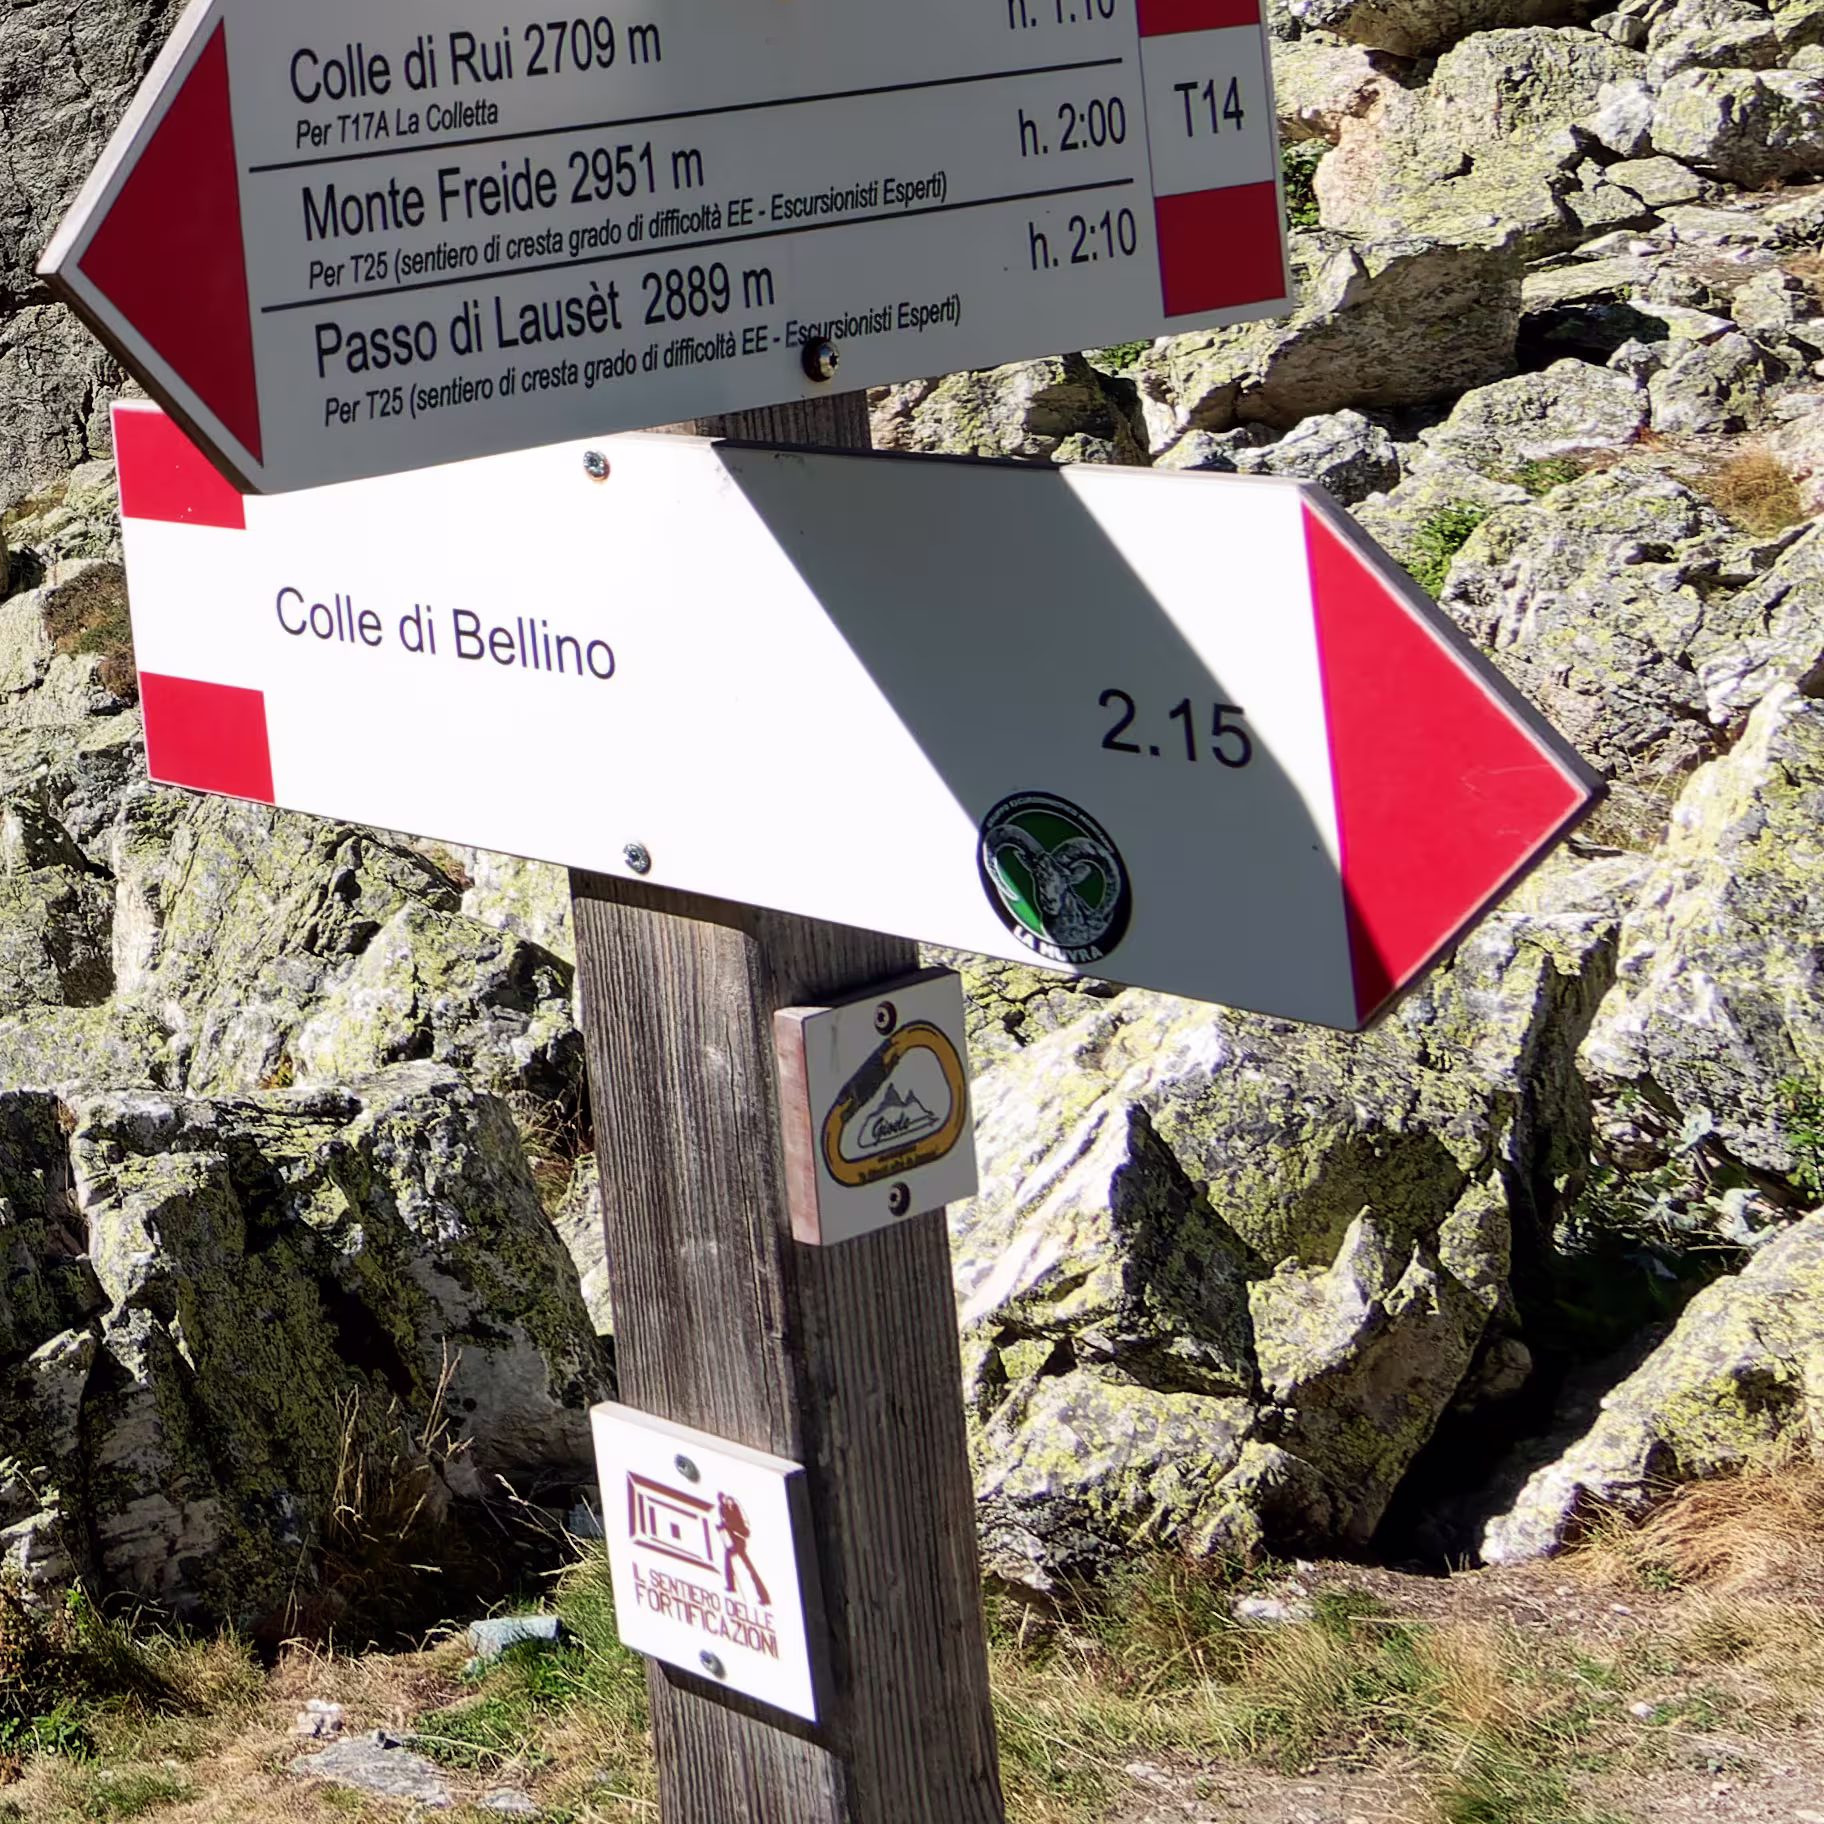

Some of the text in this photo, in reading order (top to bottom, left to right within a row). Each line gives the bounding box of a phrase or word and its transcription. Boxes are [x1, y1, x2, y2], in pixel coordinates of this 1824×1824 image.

[290, 16, 661, 104] Colle di Rui 2709 m
[296, 99, 498, 149] Per T17A La Colletta
[1018, 97, 1126, 157] h. 2:00
[1174, 76, 1244, 137] T14
[302, 141, 704, 241] Monte Freide 2951 m
[309, 260, 345, 290] Per
[350, 251, 388, 283] T25
[394, 242, 478, 284] (sentiero
[484, 234, 500, 263] di
[506, 228, 563, 260] cresta
[569, 218, 621, 257] grado
[627, 214, 643, 242] di
[649, 203, 722, 239] difficoltà
[727, 198, 753, 227] EE
[771, 180, 878, 221] Escursionisti
[883, 171, 947, 208] Esperti)
[1029, 208, 1136, 270] h. 2:10
[315, 262, 774, 378] Passo di Lausèt 2889 m
[325, 397, 360, 427] Per
[366, 386, 403, 419] T25
[410, 376, 493, 419] (sentiero
[499, 366, 515, 396] di
[521, 360, 578, 392] cresta
[584, 349, 637, 389] grado
[642, 344, 658, 372] di
[663, 331, 736, 368] difficoltà
[742, 325, 768, 356] EE
[786, 305, 892, 349] Escursionisti
[898, 293, 960, 332] Esperti)
[277, 587, 615, 679] Colle di Bellino
[1099, 689, 1252, 768] 2.15
[634, 1581, 780, 1660] FORTIFICAZIONI
[649, 1568, 721, 1612] SENTIERO
[725, 1597, 775, 1634] DELLE
